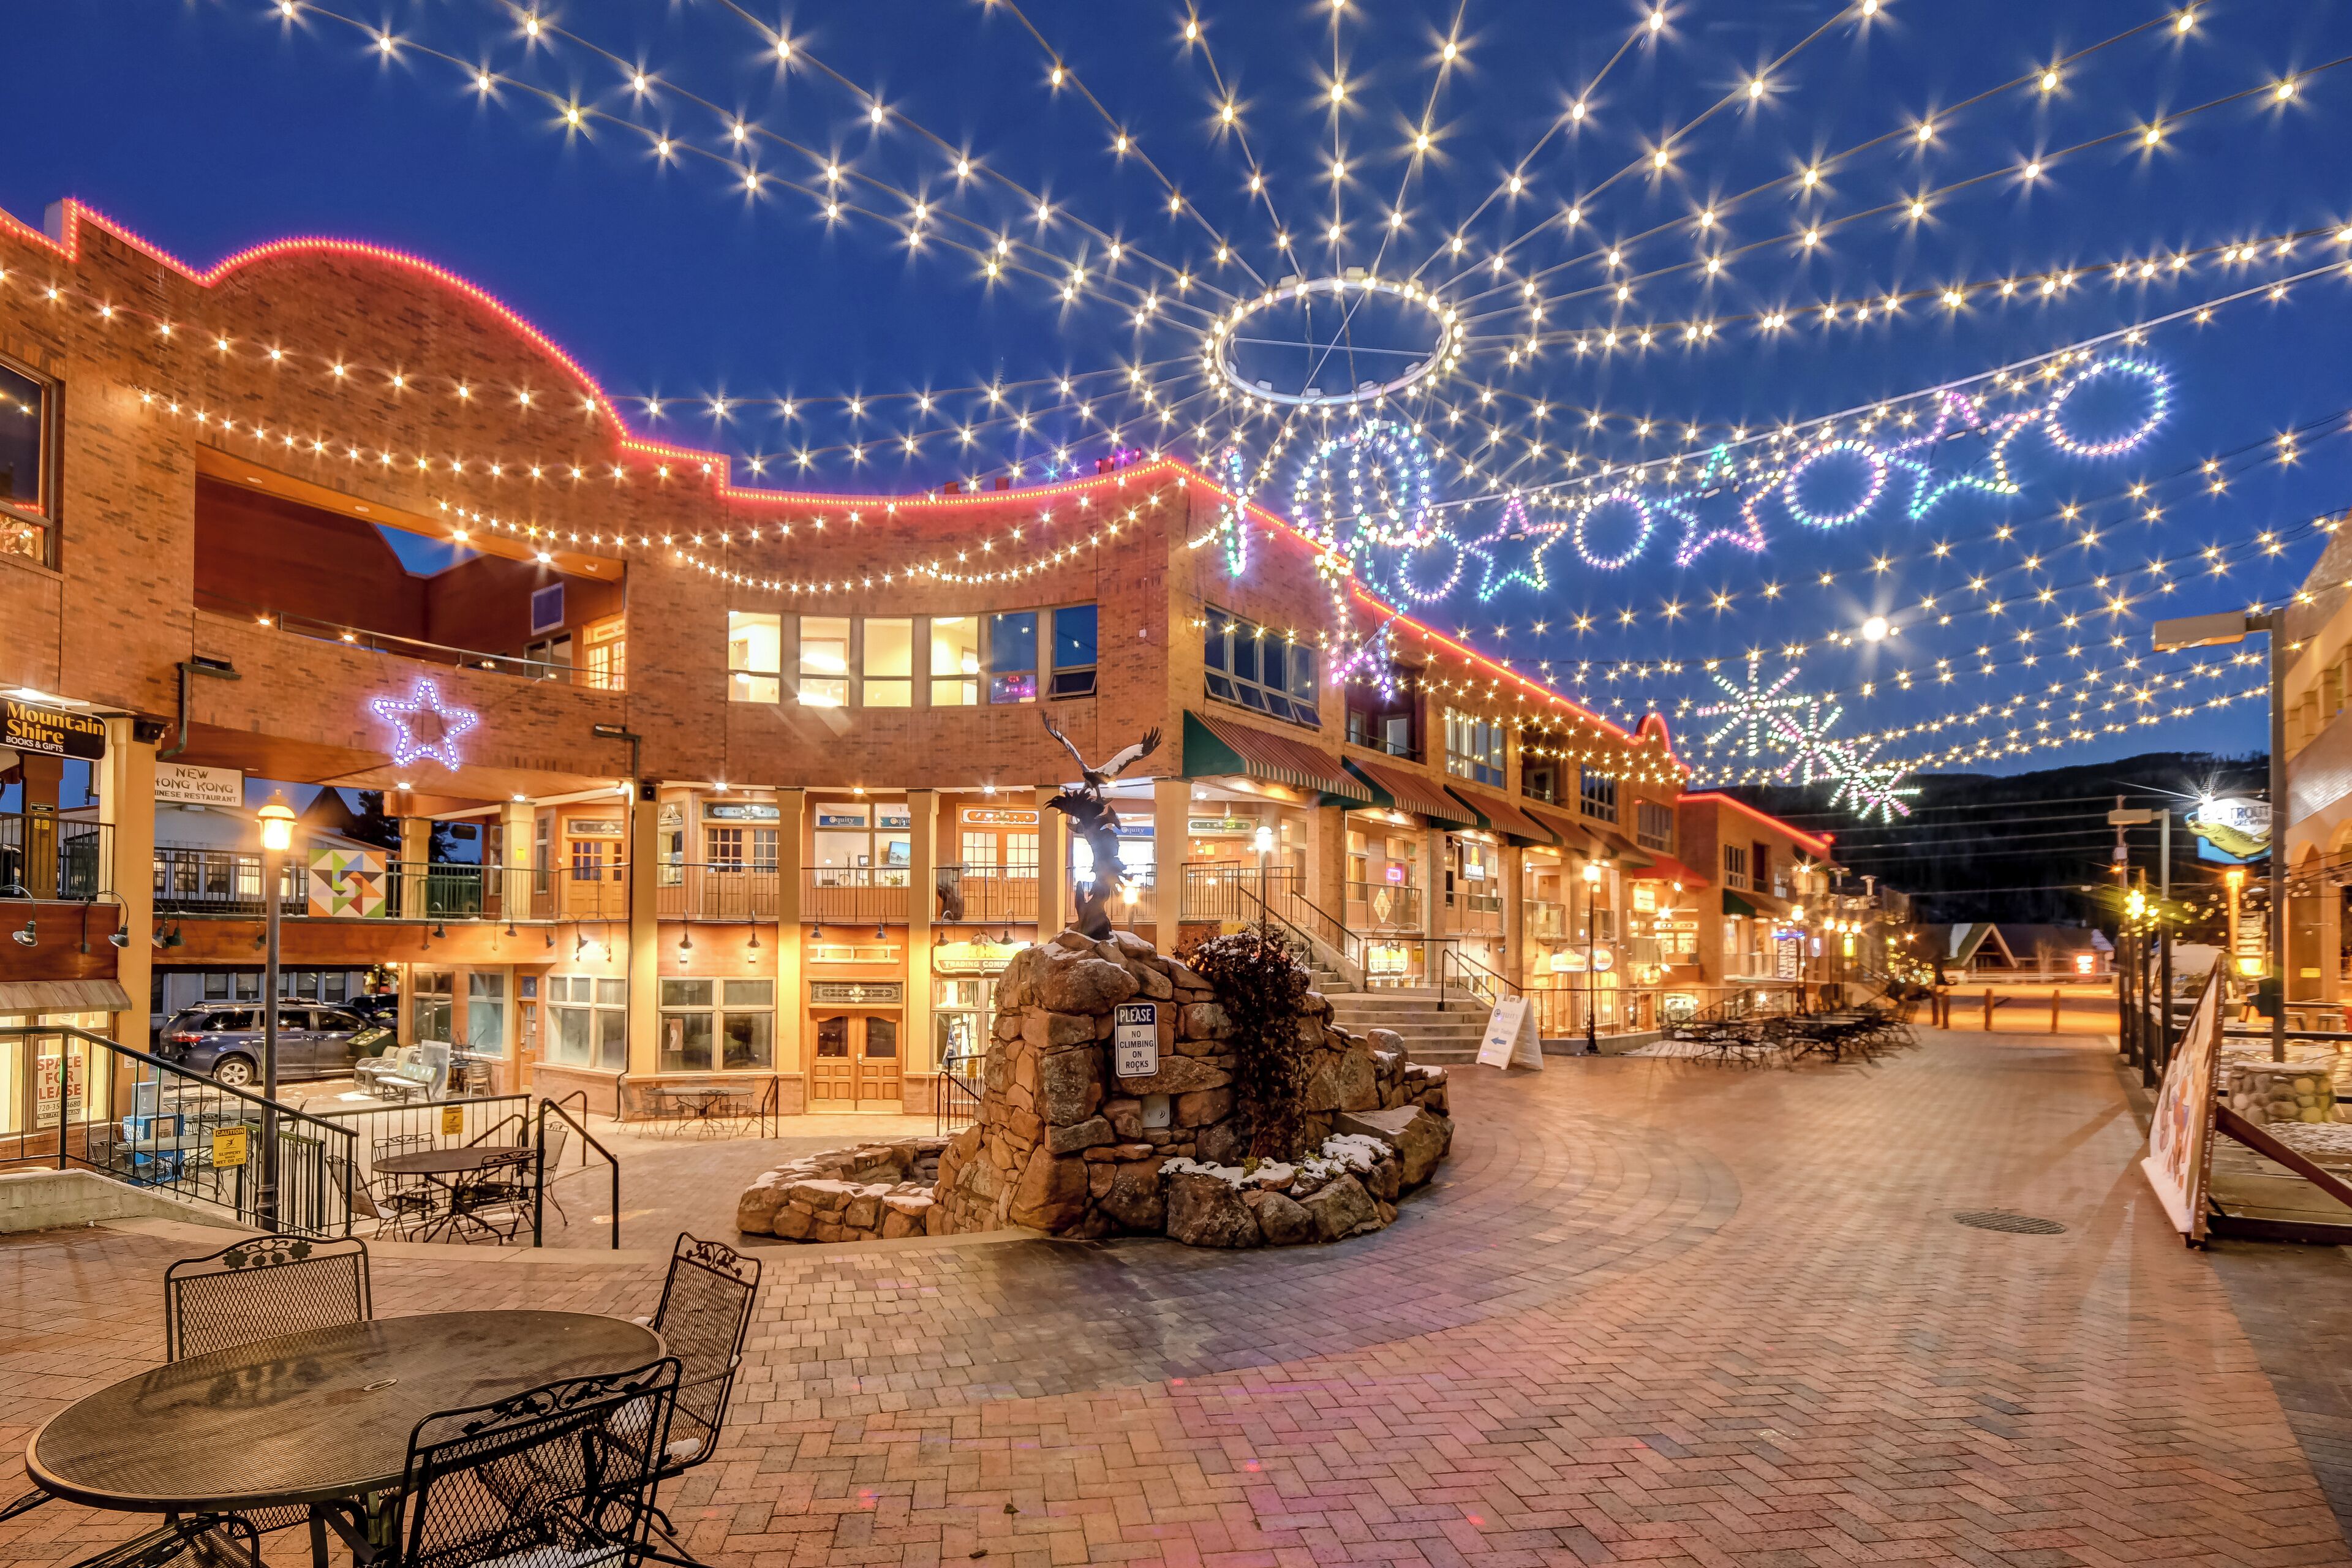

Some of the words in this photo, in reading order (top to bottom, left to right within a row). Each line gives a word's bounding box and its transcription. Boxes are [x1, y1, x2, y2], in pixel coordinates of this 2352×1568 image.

[7, 701, 104, 736] Mountain
[7, 719, 64, 744] Shire
[6, 736, 34, 747] BOOKS
[42, 742, 64, 753] GIFTS
[176, 767, 209, 780] NEW
[197, 781, 233, 794] KONG
[184, 792, 237, 803] RESTAURANT
[1120, 1008, 1152, 1023] PLEASE
[1119, 1040, 1154, 1049] CLIMBING
[1125, 1060, 1149, 1069] ROCKS
[45, 1071, 74, 1085] FOR
[126, 1124, 144, 1133] DALY
